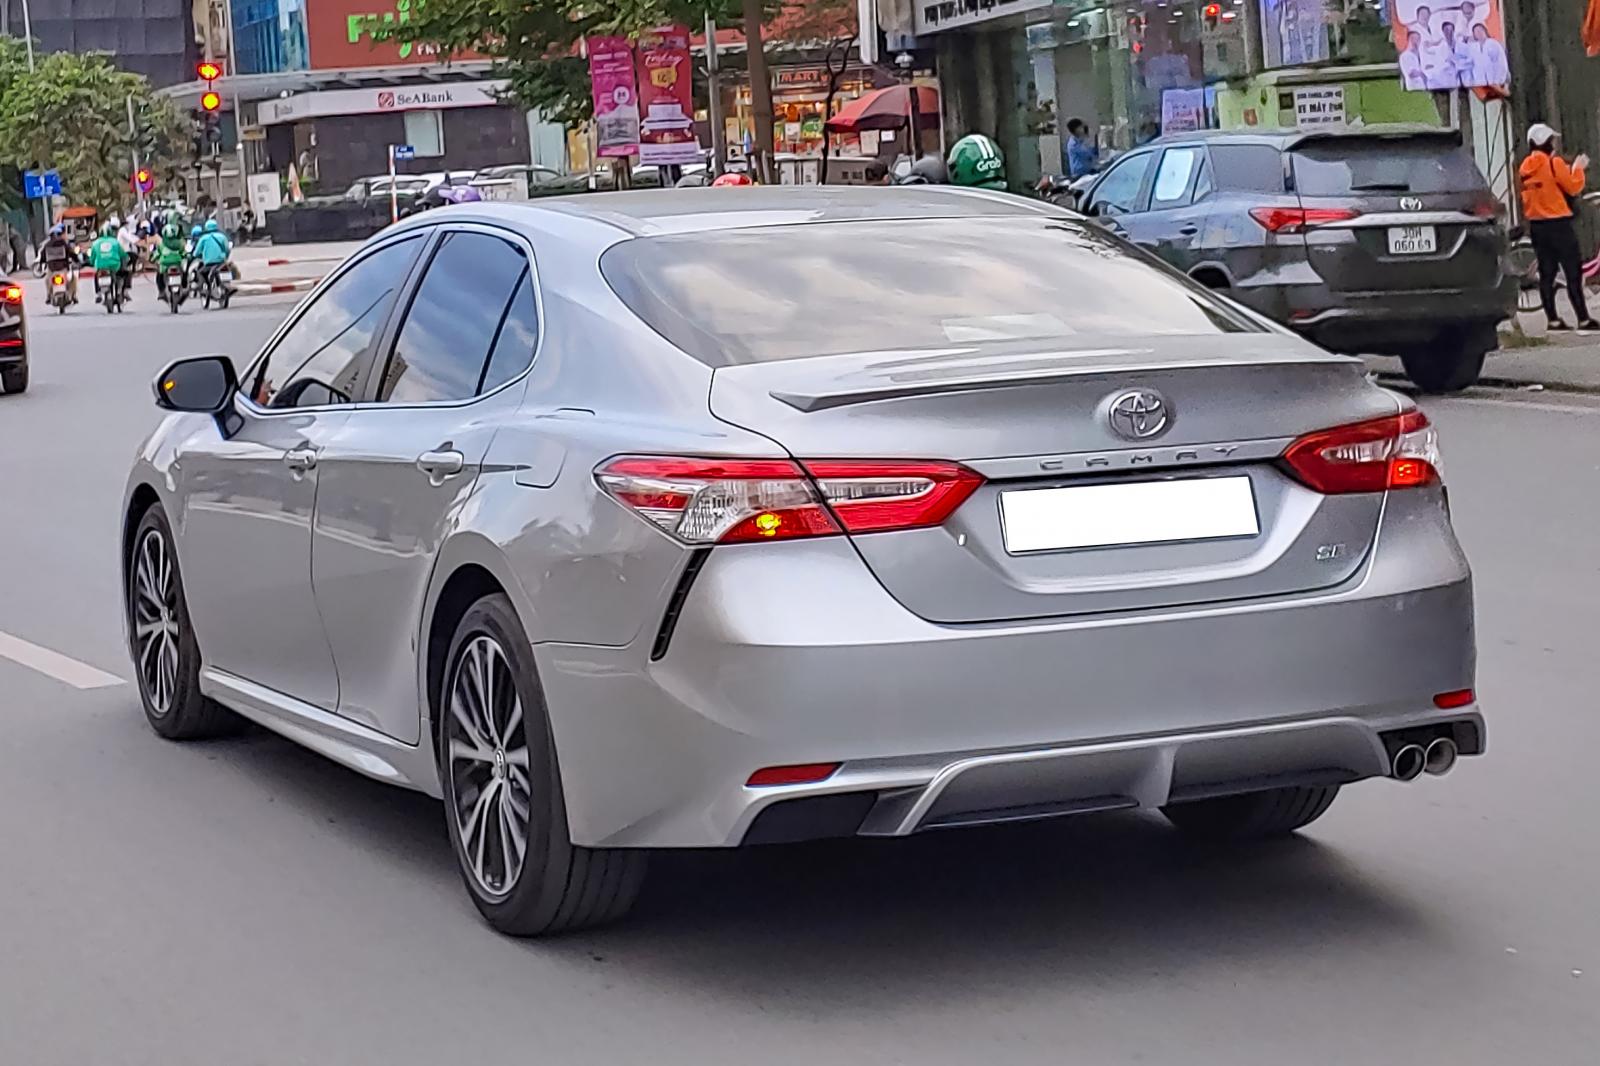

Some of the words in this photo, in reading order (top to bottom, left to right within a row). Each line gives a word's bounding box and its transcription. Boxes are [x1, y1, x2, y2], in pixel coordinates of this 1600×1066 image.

[397, 90, 453, 105] SeABank
[976, 157, 1002, 172] Grab
[1039, 445, 1239, 471] CAMRY
